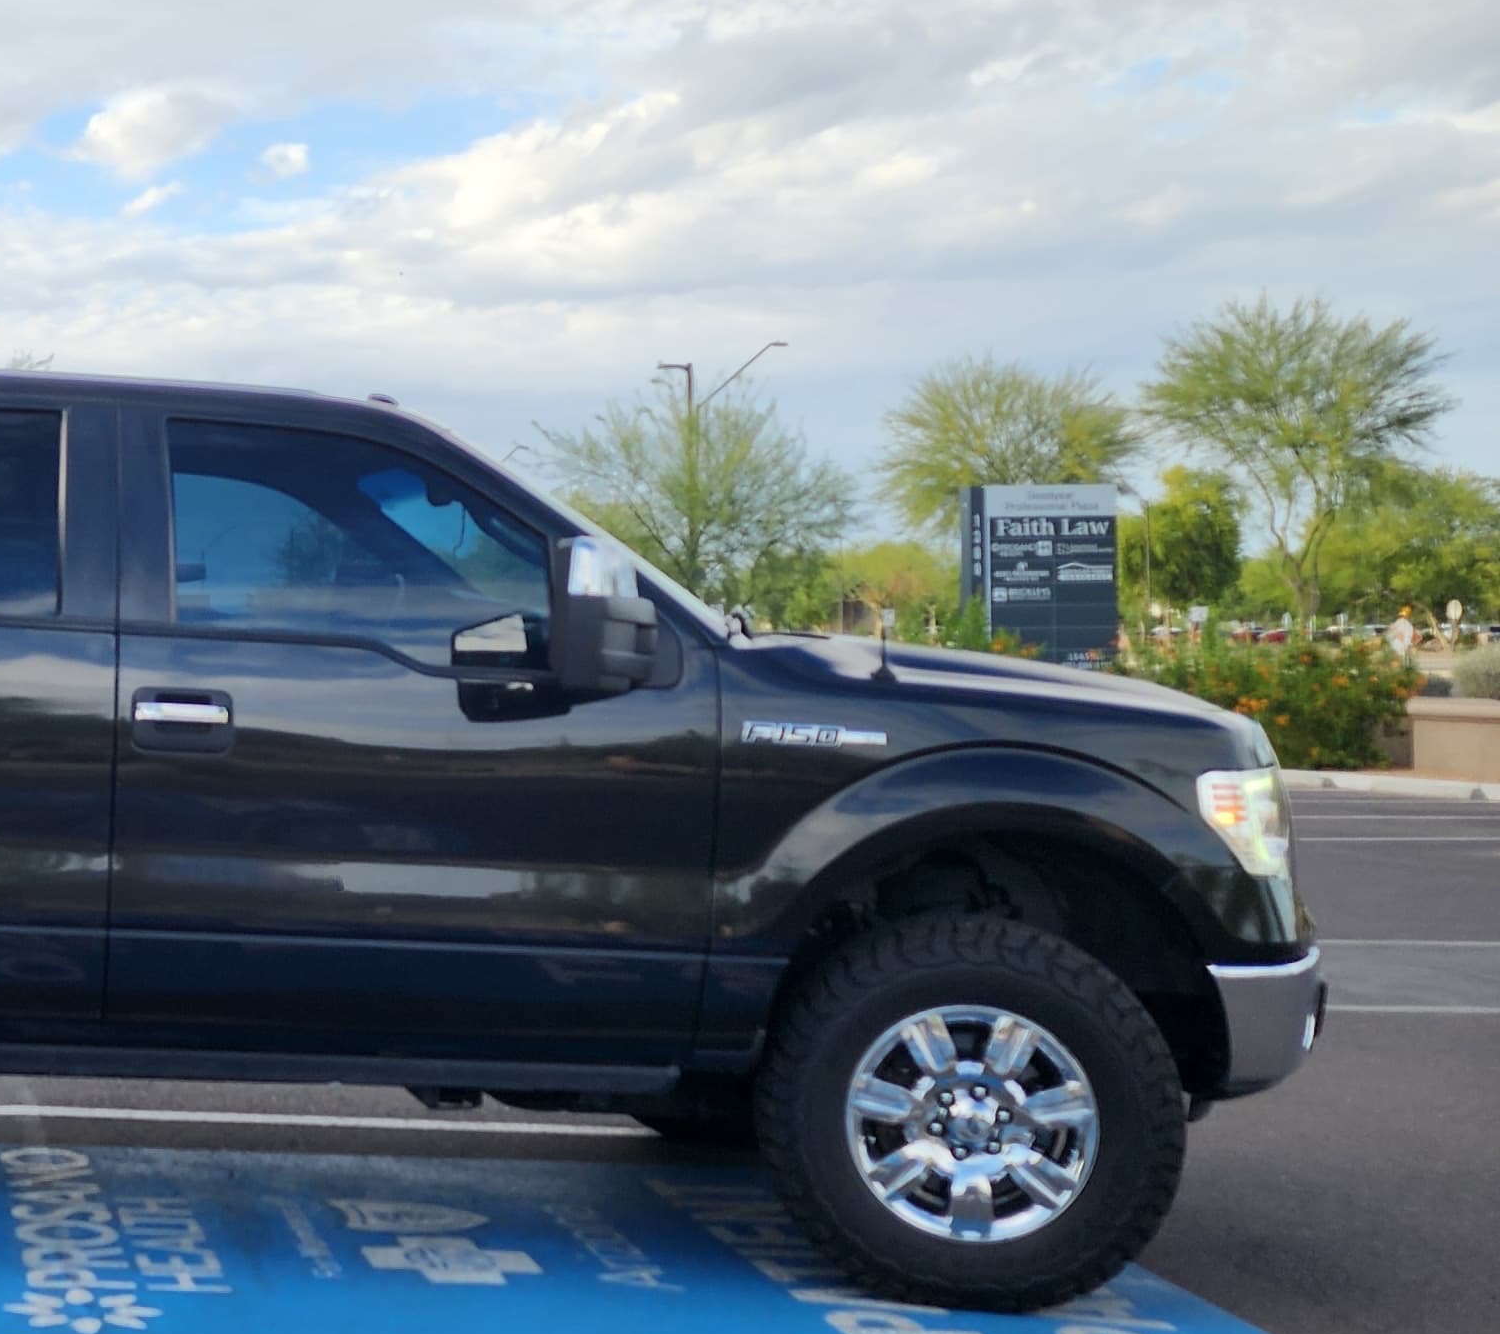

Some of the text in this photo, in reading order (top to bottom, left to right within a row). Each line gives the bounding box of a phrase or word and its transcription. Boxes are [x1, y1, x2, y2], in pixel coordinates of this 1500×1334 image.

[995, 518, 1109, 537] Faith Law
[0, 1147, 137, 1291] PROSANO
[114, 1197, 233, 1294] HEALTH
